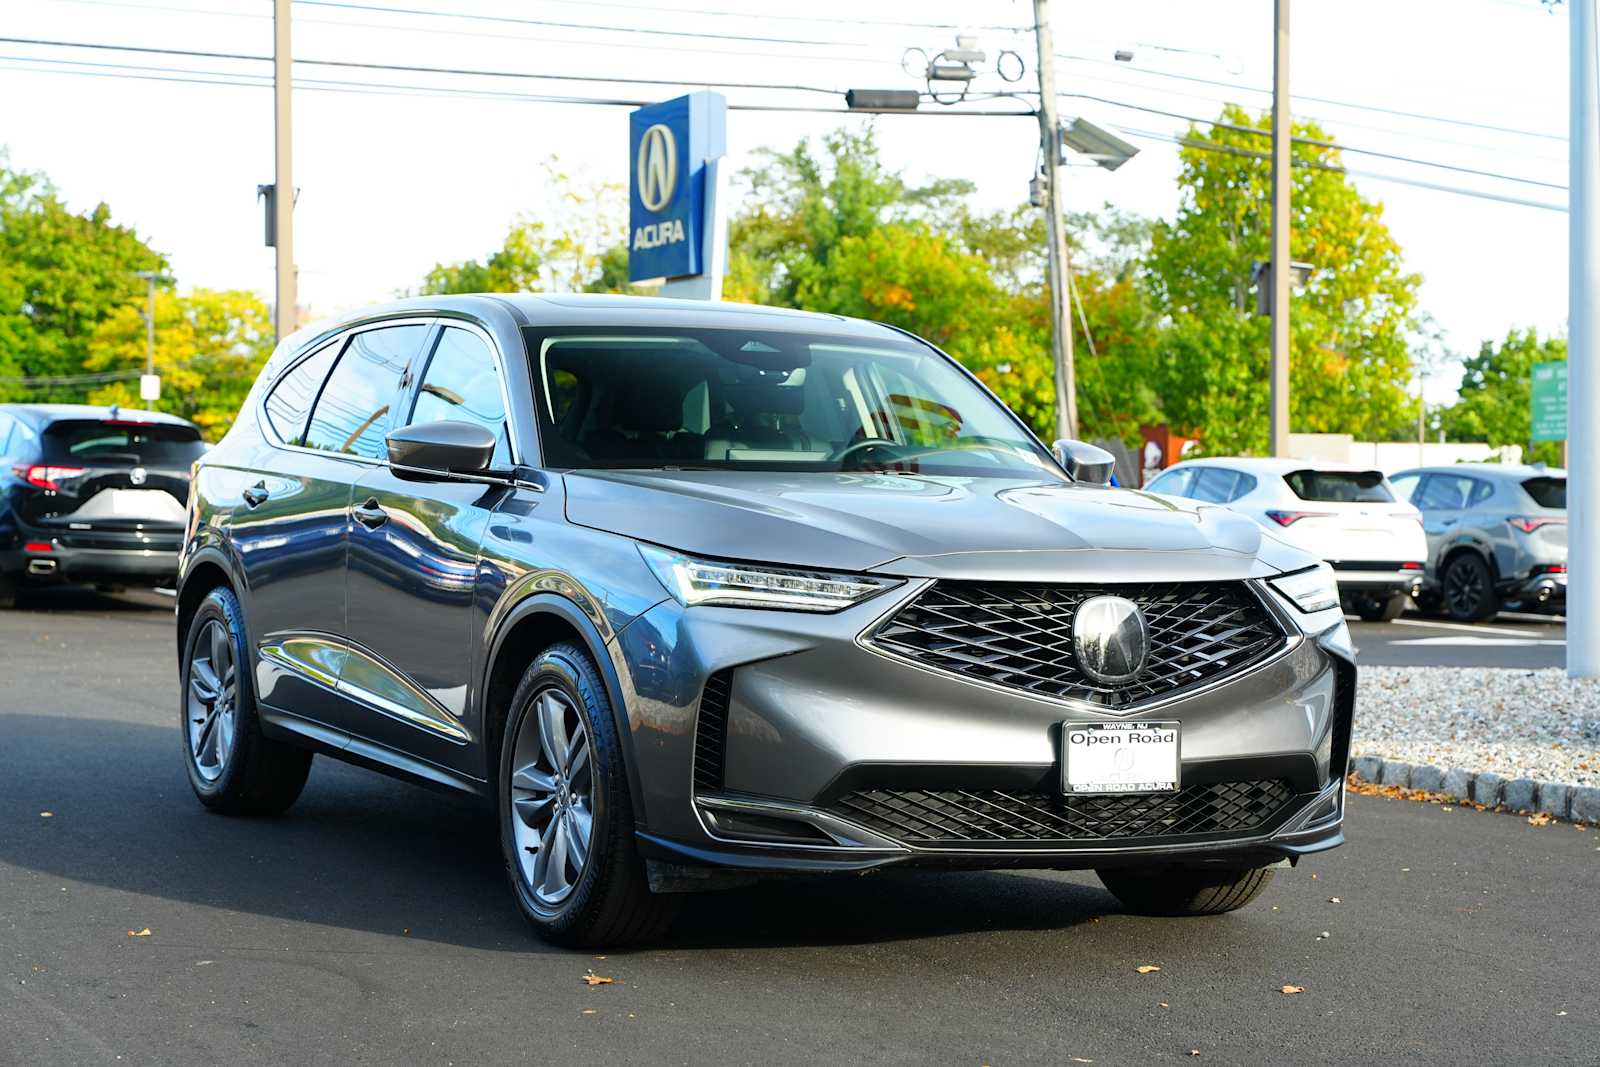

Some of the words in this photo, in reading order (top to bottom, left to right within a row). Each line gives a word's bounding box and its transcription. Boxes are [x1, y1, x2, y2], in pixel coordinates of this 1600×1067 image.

[633, 219, 685, 251] ACURA
[1136, 722, 1148, 730] NJ
[1071, 733, 1121, 747] Open
[1128, 732, 1174, 744] Road
[1073, 784, 1103, 793] OPEN
[1105, 783, 1136, 792] ROAD
[1138, 782, 1174, 792] ACURA
